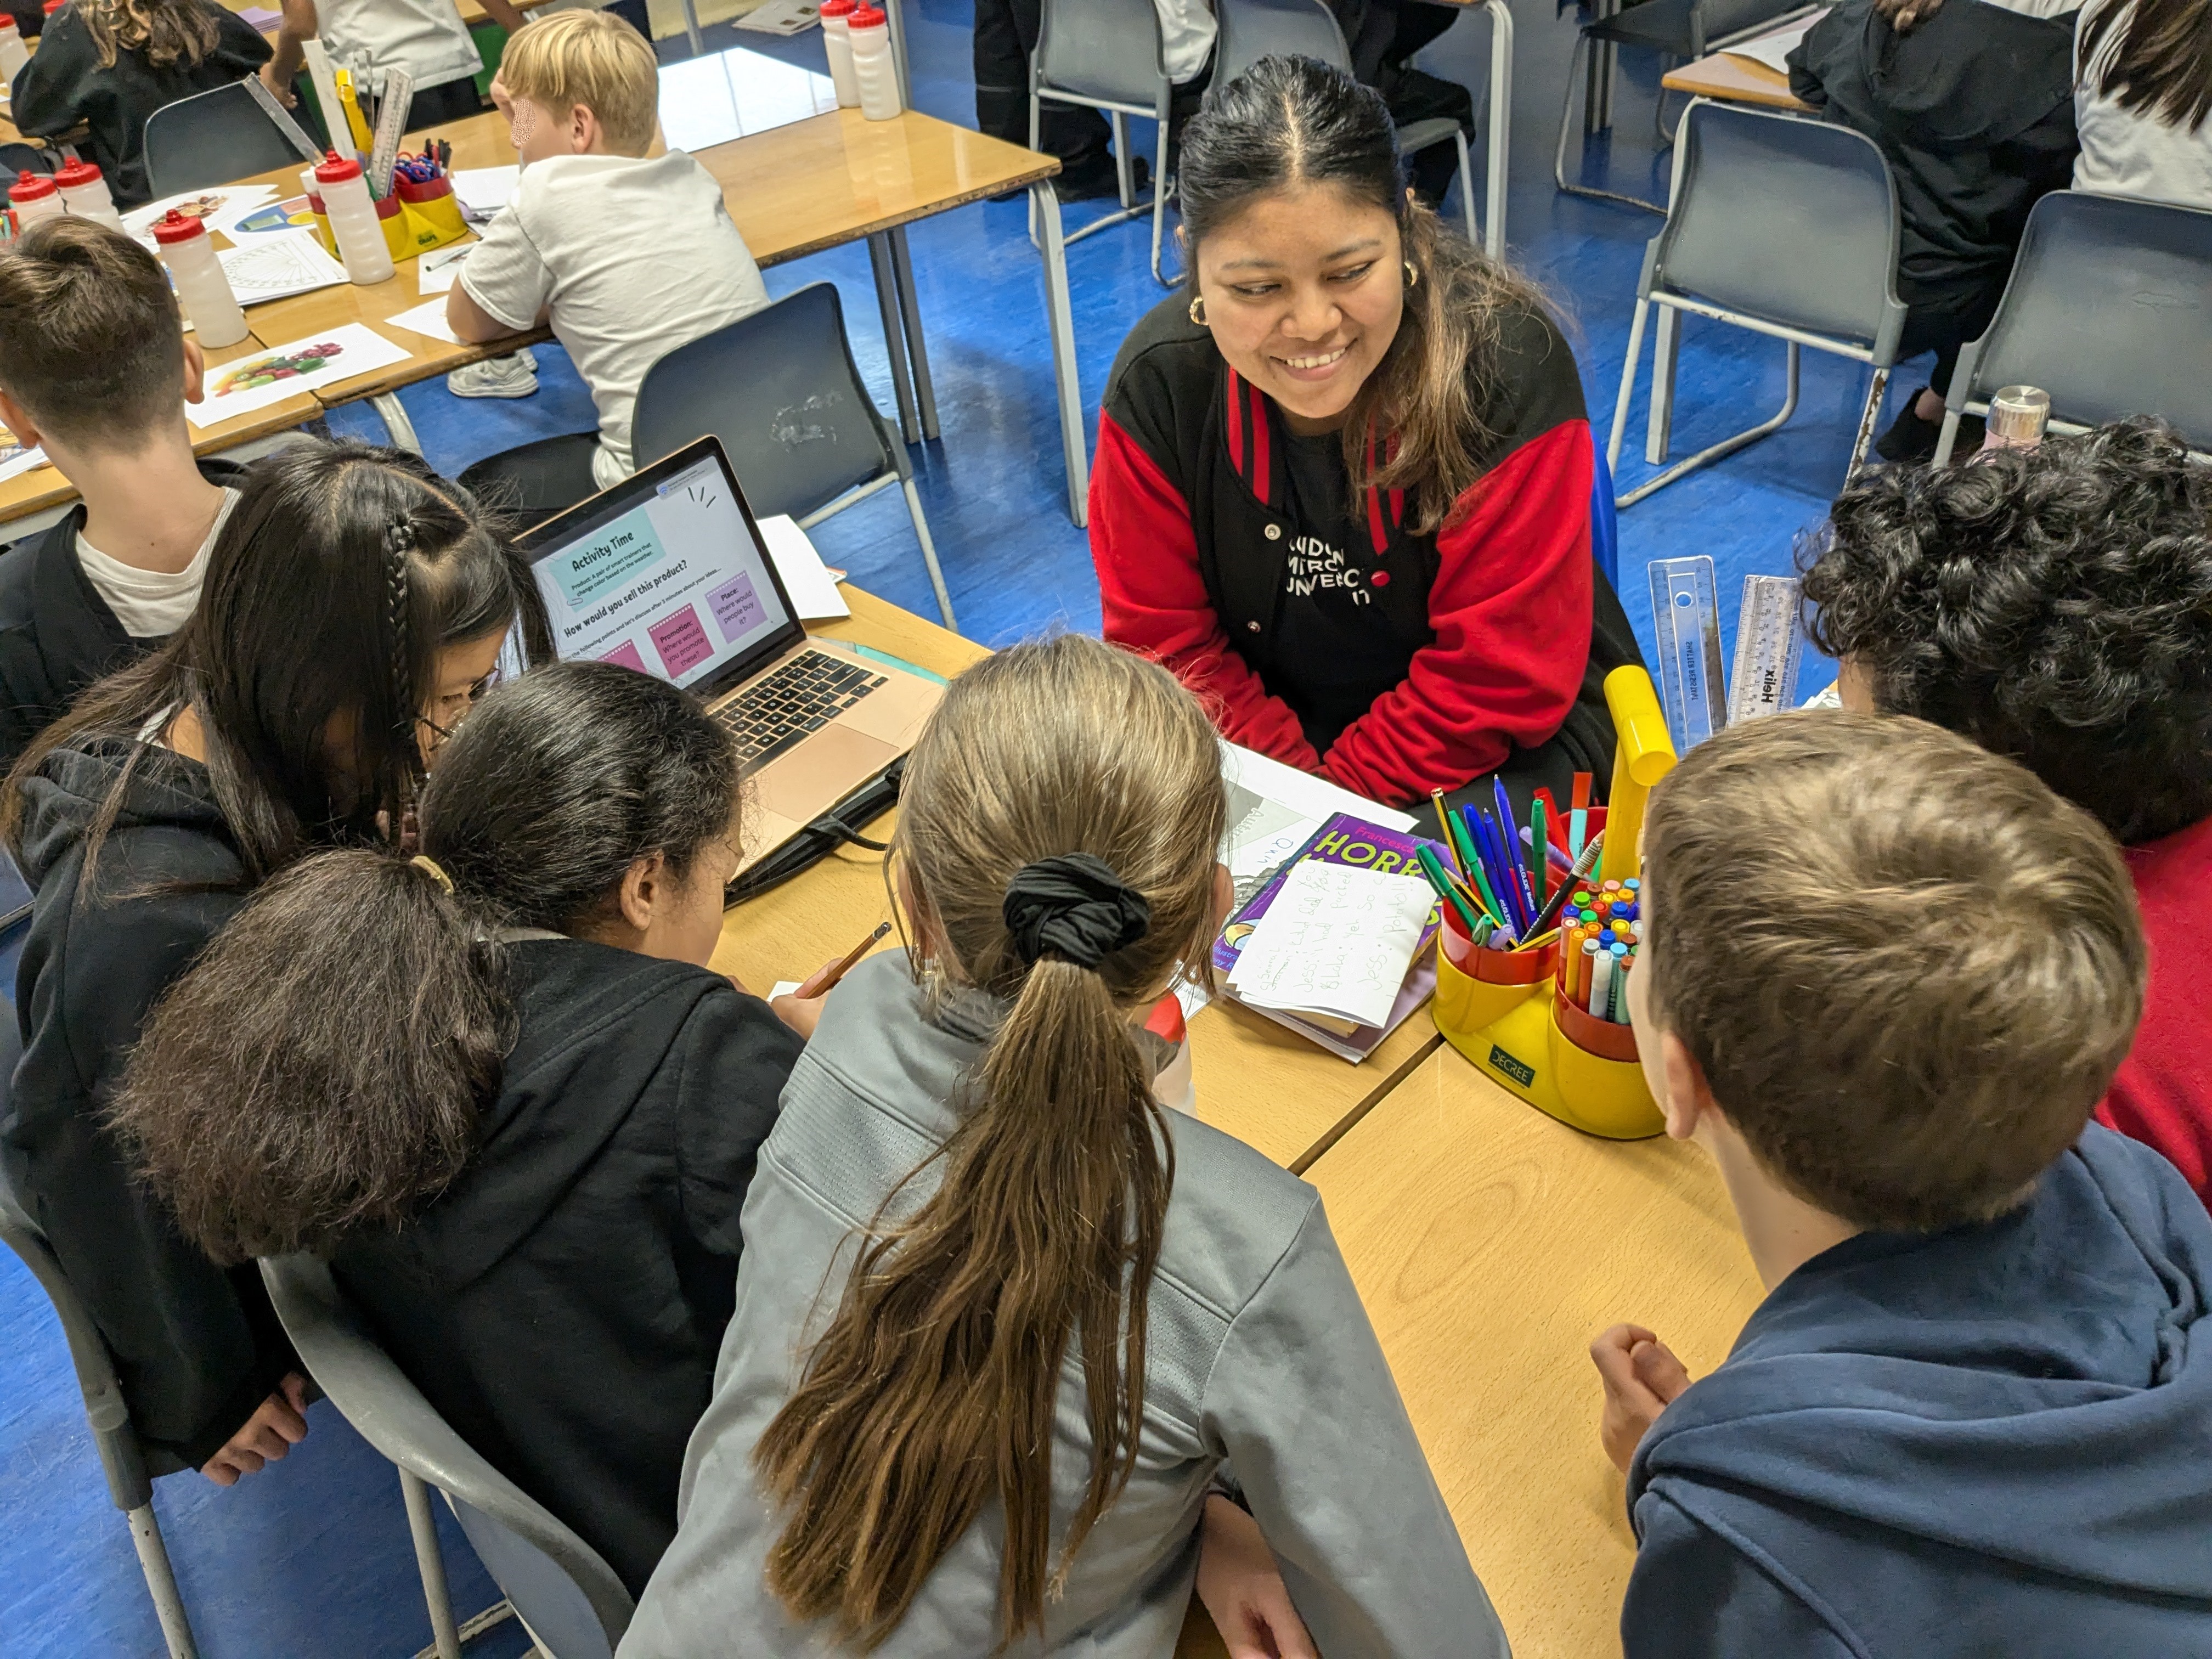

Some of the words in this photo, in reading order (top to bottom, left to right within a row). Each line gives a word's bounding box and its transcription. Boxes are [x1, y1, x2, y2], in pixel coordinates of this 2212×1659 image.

[572, 545, 612, 572] Activity
[610, 532, 634, 549] Time
[596, 569, 605, 578] pair
[611, 558, 625, 568] smart
[624, 549, 642, 560] trainers
[641, 542, 652, 551] that
[577, 585, 594, 597] change
[594, 578, 606, 588] color
[606, 569, 620, 580] based
[634, 551, 654, 564] weather.
[563, 623, 582, 638] How
[583, 610, 608, 627] would
[607, 599, 624, 614] you
[624, 589, 638, 604] sell
[637, 581, 653, 595] this
[653, 560, 687, 588] product?
[716, 602, 735, 616] Where
[735, 590, 752, 605] would
[721, 588, 739, 601] Place:
[579, 637, 602, 652] following
[601, 629, 616, 641] points
[616, 623, 625, 632] and
[625, 616, 635, 626] let's
[635, 608, 652, 620] discuss
[651, 601, 662, 611] after
[665, 589, 683, 602] minutes
[683, 582, 696, 592] about
[695, 575, 706, 587] your
[724, 608, 743, 624] people
[743, 601, 754, 611] buy
[659, 620, 693, 643] Promotion:
[663, 639, 682, 653] Where
[682, 627, 701, 641] would
[667, 652, 680, 664] you
[680, 637, 704, 657] promote
[680, 651, 699, 667] these?
[1355, 826, 1415, 854] Francesca
[1314, 831, 1424, 877] HORR
[1526, 891, 1535, 911] Medium
[1492, 1050, 1529, 1082] DECREE
